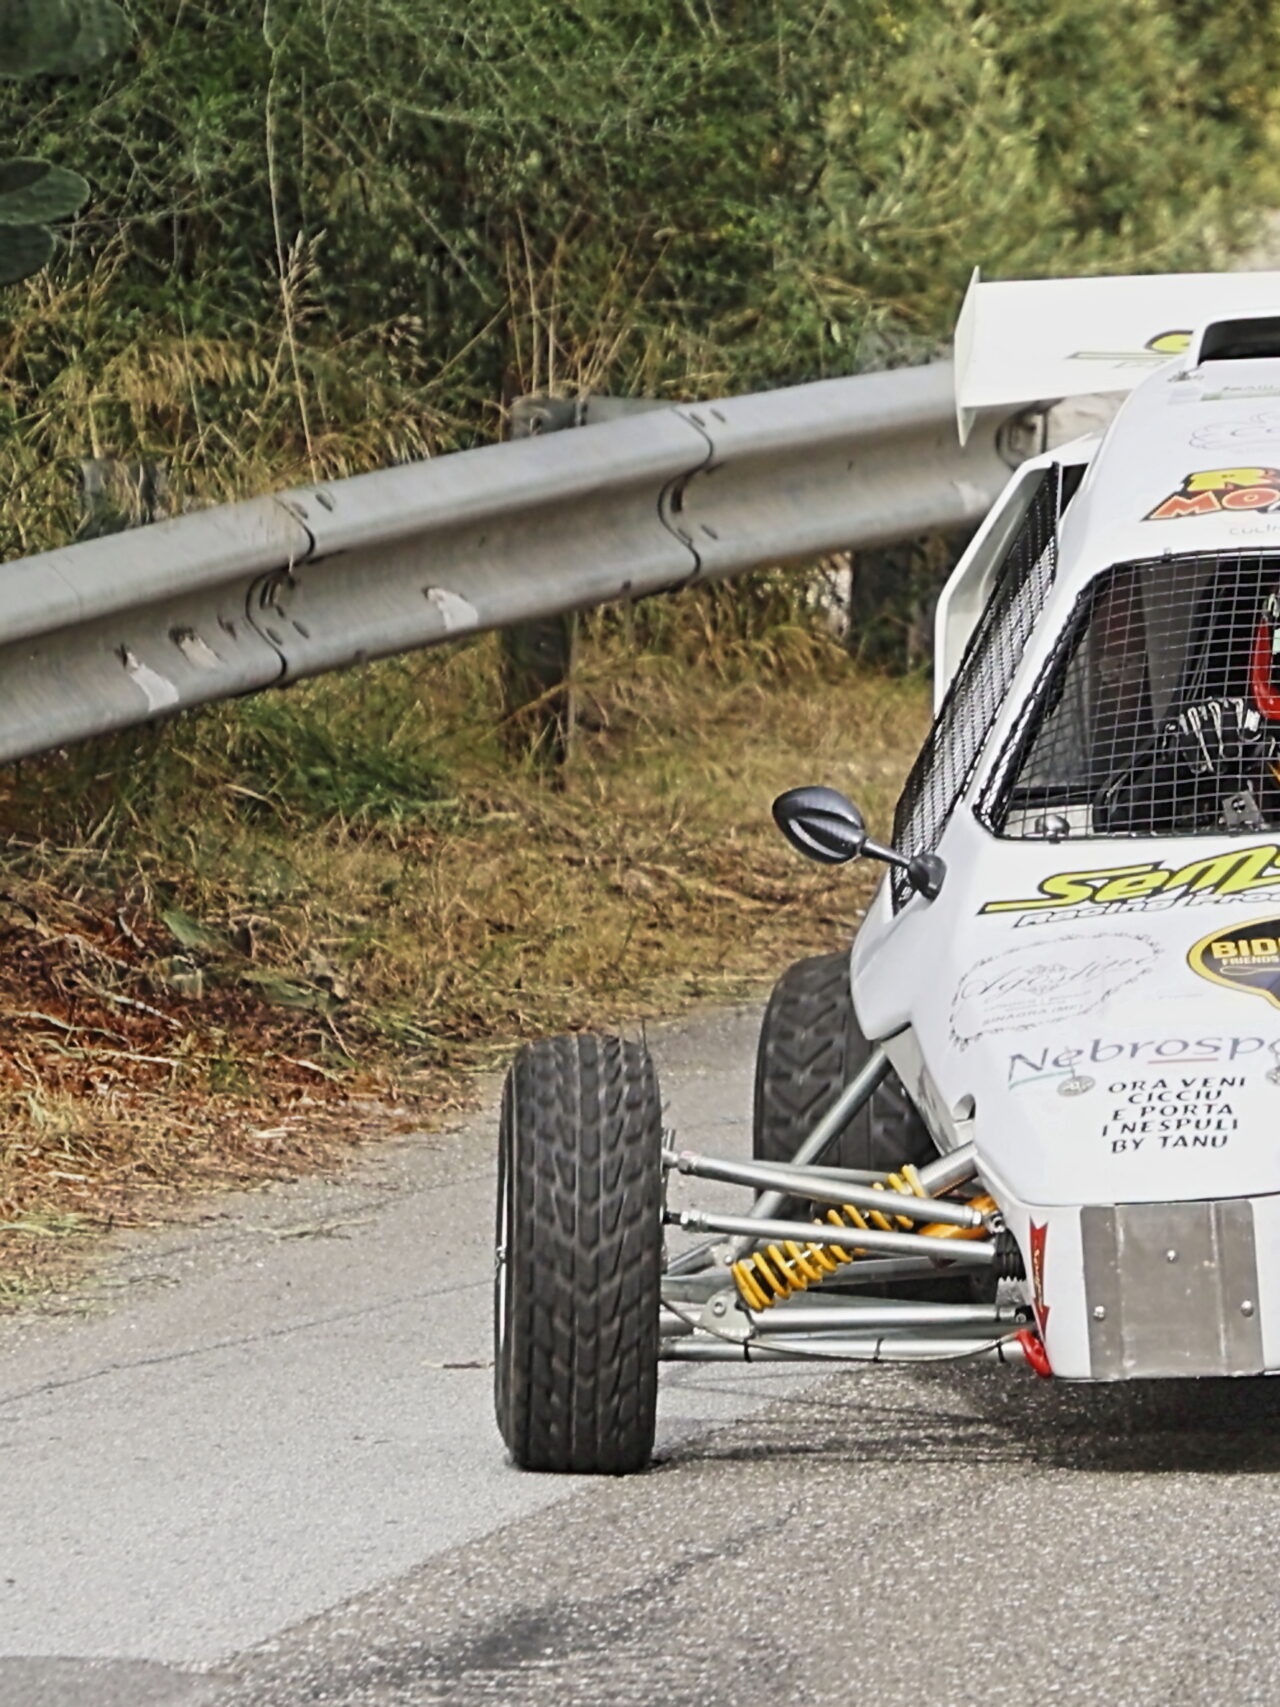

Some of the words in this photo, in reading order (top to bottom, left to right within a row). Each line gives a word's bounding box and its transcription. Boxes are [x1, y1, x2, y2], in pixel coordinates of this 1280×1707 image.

[1013, 897, 1180, 929] Racing
[1221, 955, 1279, 966] FRIENDS
[1108, 1079, 1168, 1094] ORA
[1181, 1077, 1246, 1087] VENI
[1127, 1090, 1222, 1104] CICCIU
[1112, 1110, 1124, 1121] E
[1140, 1104, 1233, 1117] PORTA
[1101, 1124, 1109, 1137] I
[1120, 1119, 1238, 1134] NESPULI
[1111, 1138, 1145, 1154] BY
[1160, 1136, 1228, 1148] TANU
